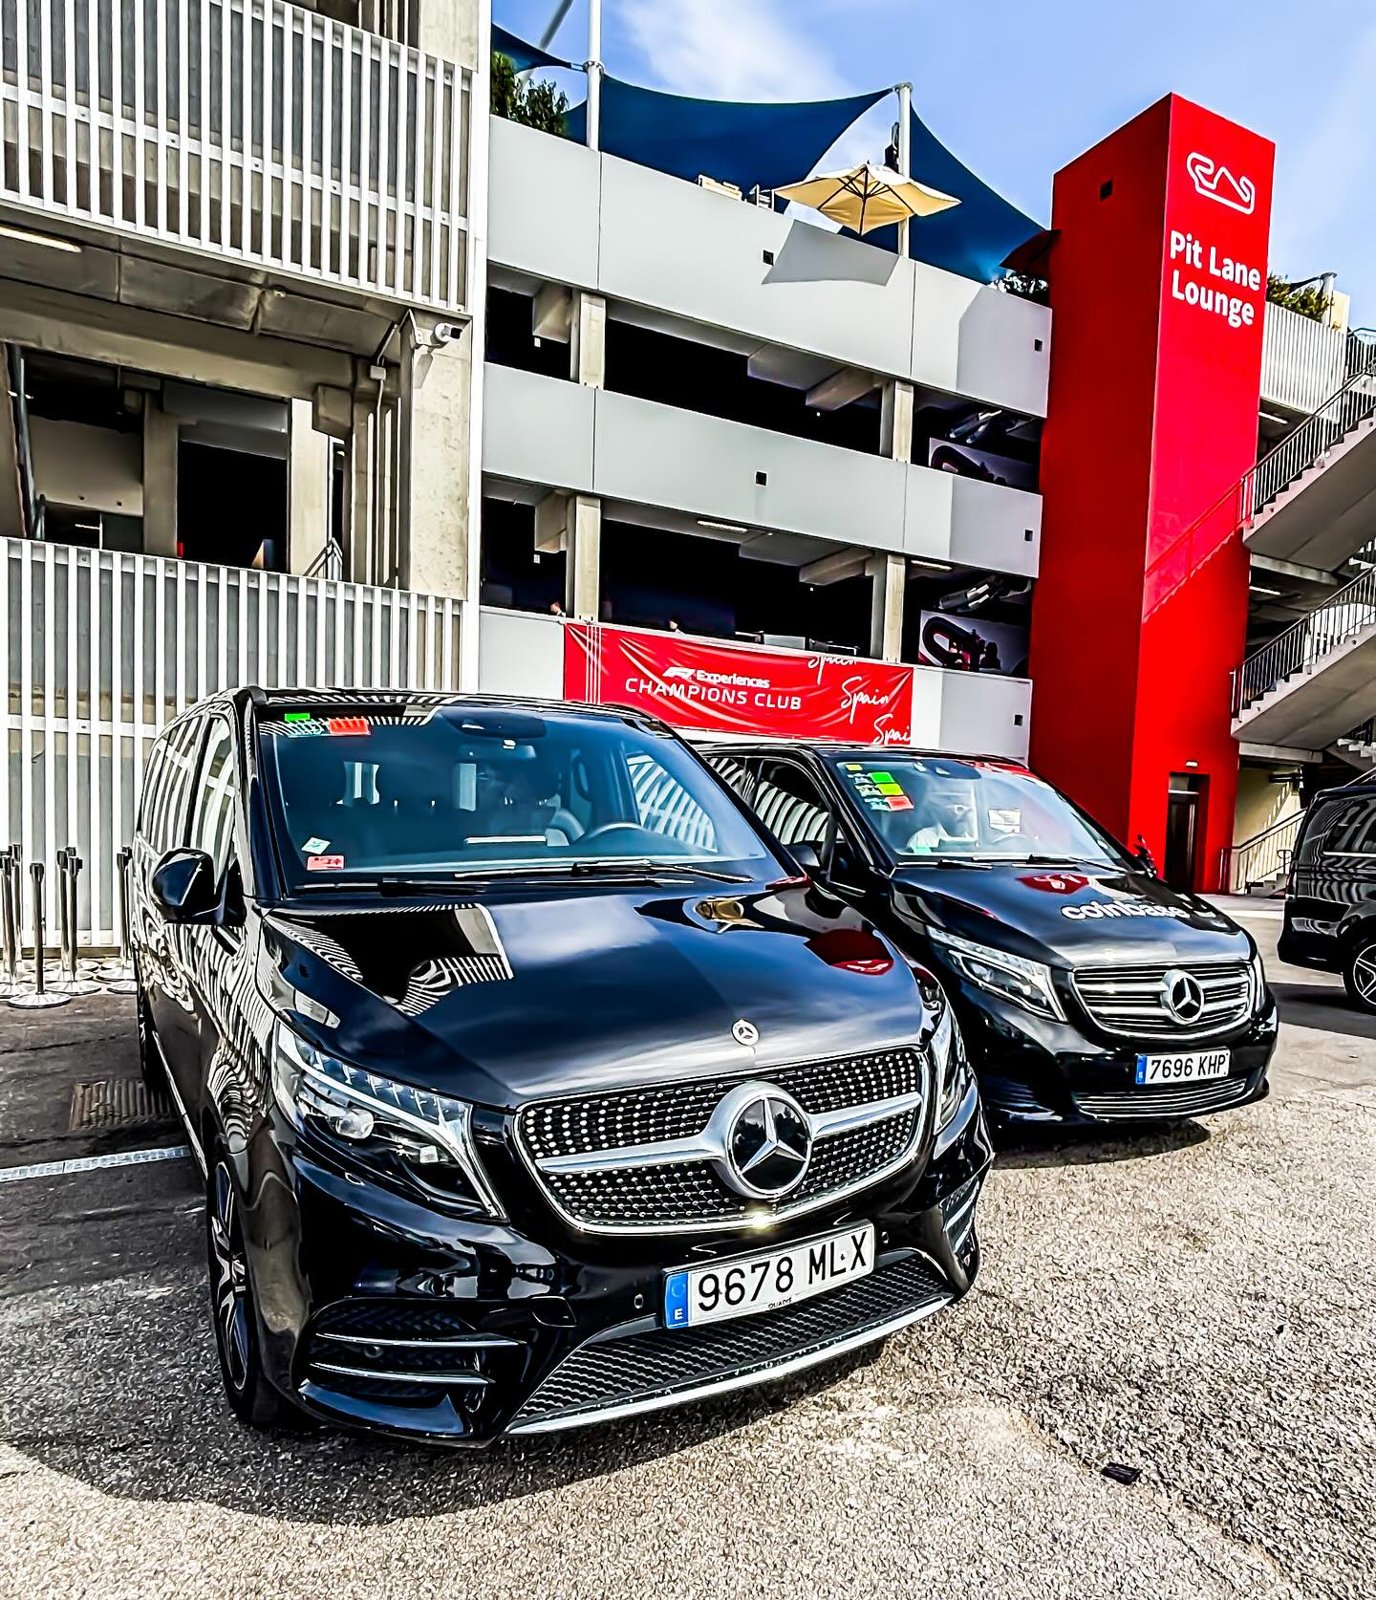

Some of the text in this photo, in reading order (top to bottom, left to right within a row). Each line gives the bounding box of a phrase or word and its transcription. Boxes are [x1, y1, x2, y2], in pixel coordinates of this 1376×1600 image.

[1170, 229, 1261, 291] Pit Lane
[1172, 269, 1255, 329] Lounge
[625, 677, 802, 710] CHAMPIONS CLUB
[697, 669, 770, 689] Experiences
[841, 676, 889, 724] Spain
[871, 713, 911, 745] Spai
[1061, 900, 1191, 920] coinbase
[1150, 1054, 1226, 1080] 7696 KHP
[698, 1231, 867, 1312] 9678 MLX
[673, 1308, 684, 1320] E
